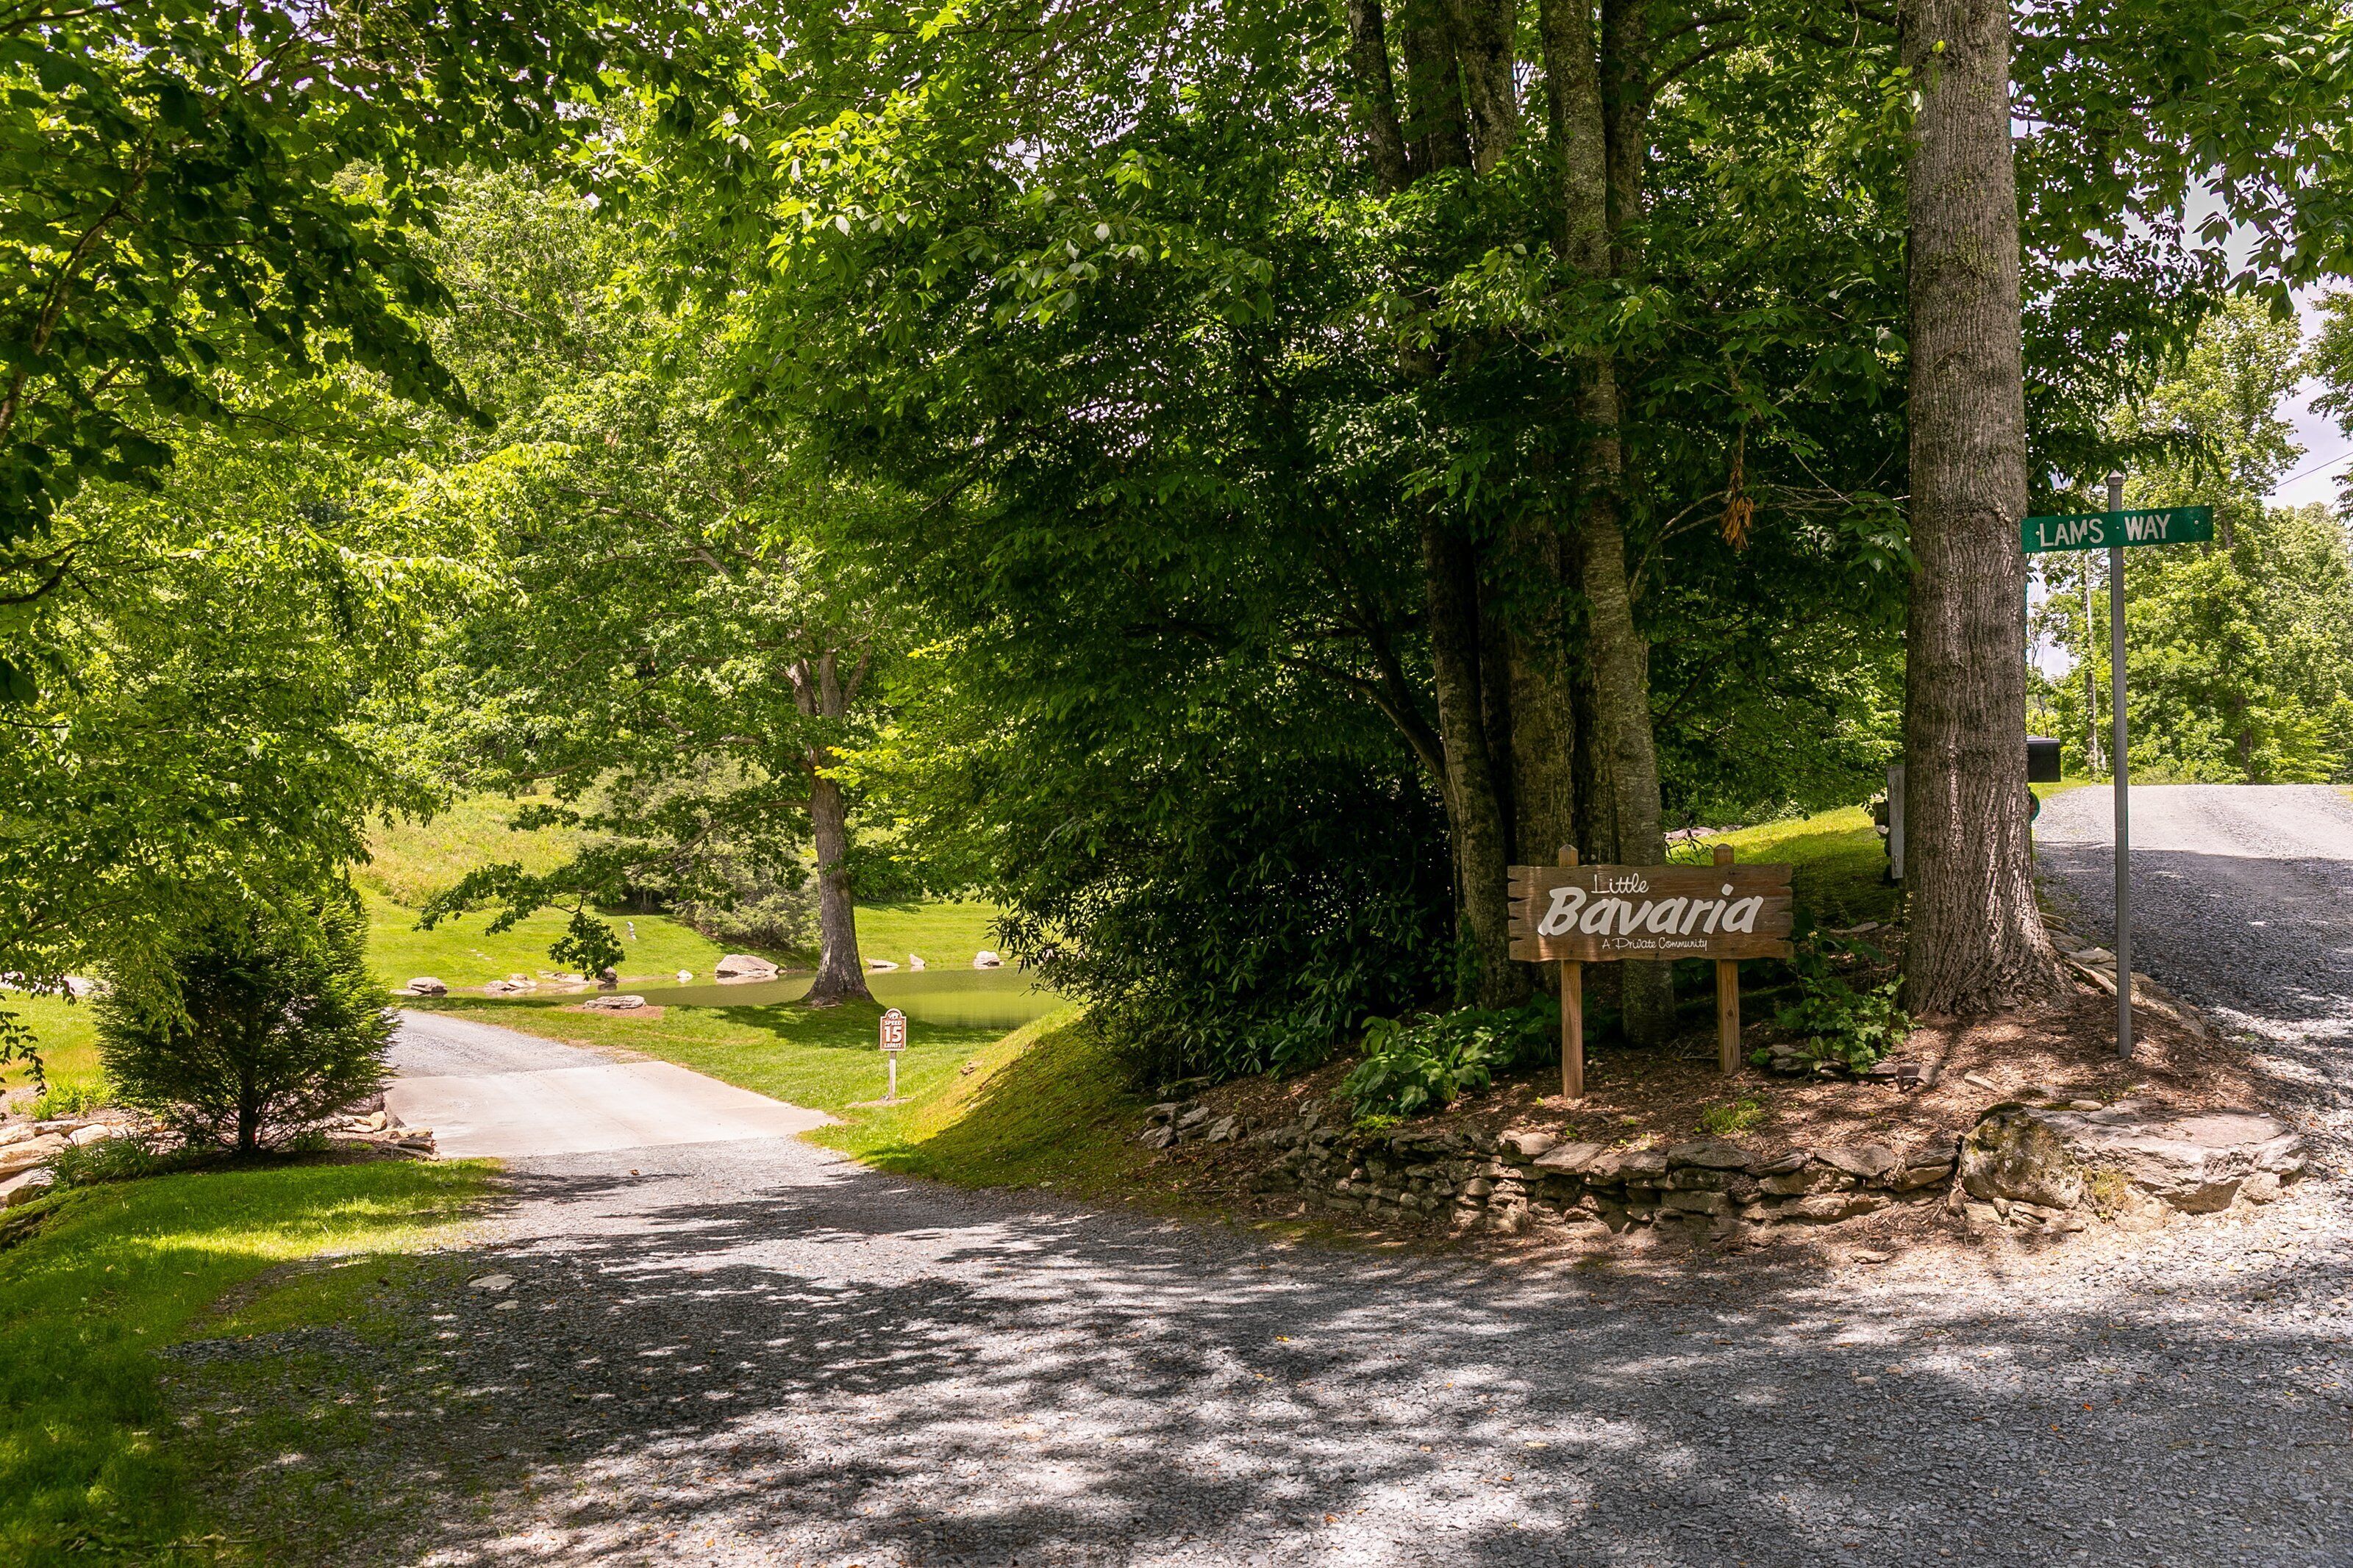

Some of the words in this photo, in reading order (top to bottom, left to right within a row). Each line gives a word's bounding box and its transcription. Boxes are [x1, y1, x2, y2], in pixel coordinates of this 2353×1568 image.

[2039, 518, 2104, 547] LAMS
[2124, 514, 2171, 541] WAY
[1591, 873, 1649, 895] Little
[1538, 884, 1764, 937] Bavaria
[1602, 939, 1611, 950] A
[1615, 938, 1657, 950] Private
[1658, 937, 1707, 952] Community
[885, 1025, 902, 1042] 15
